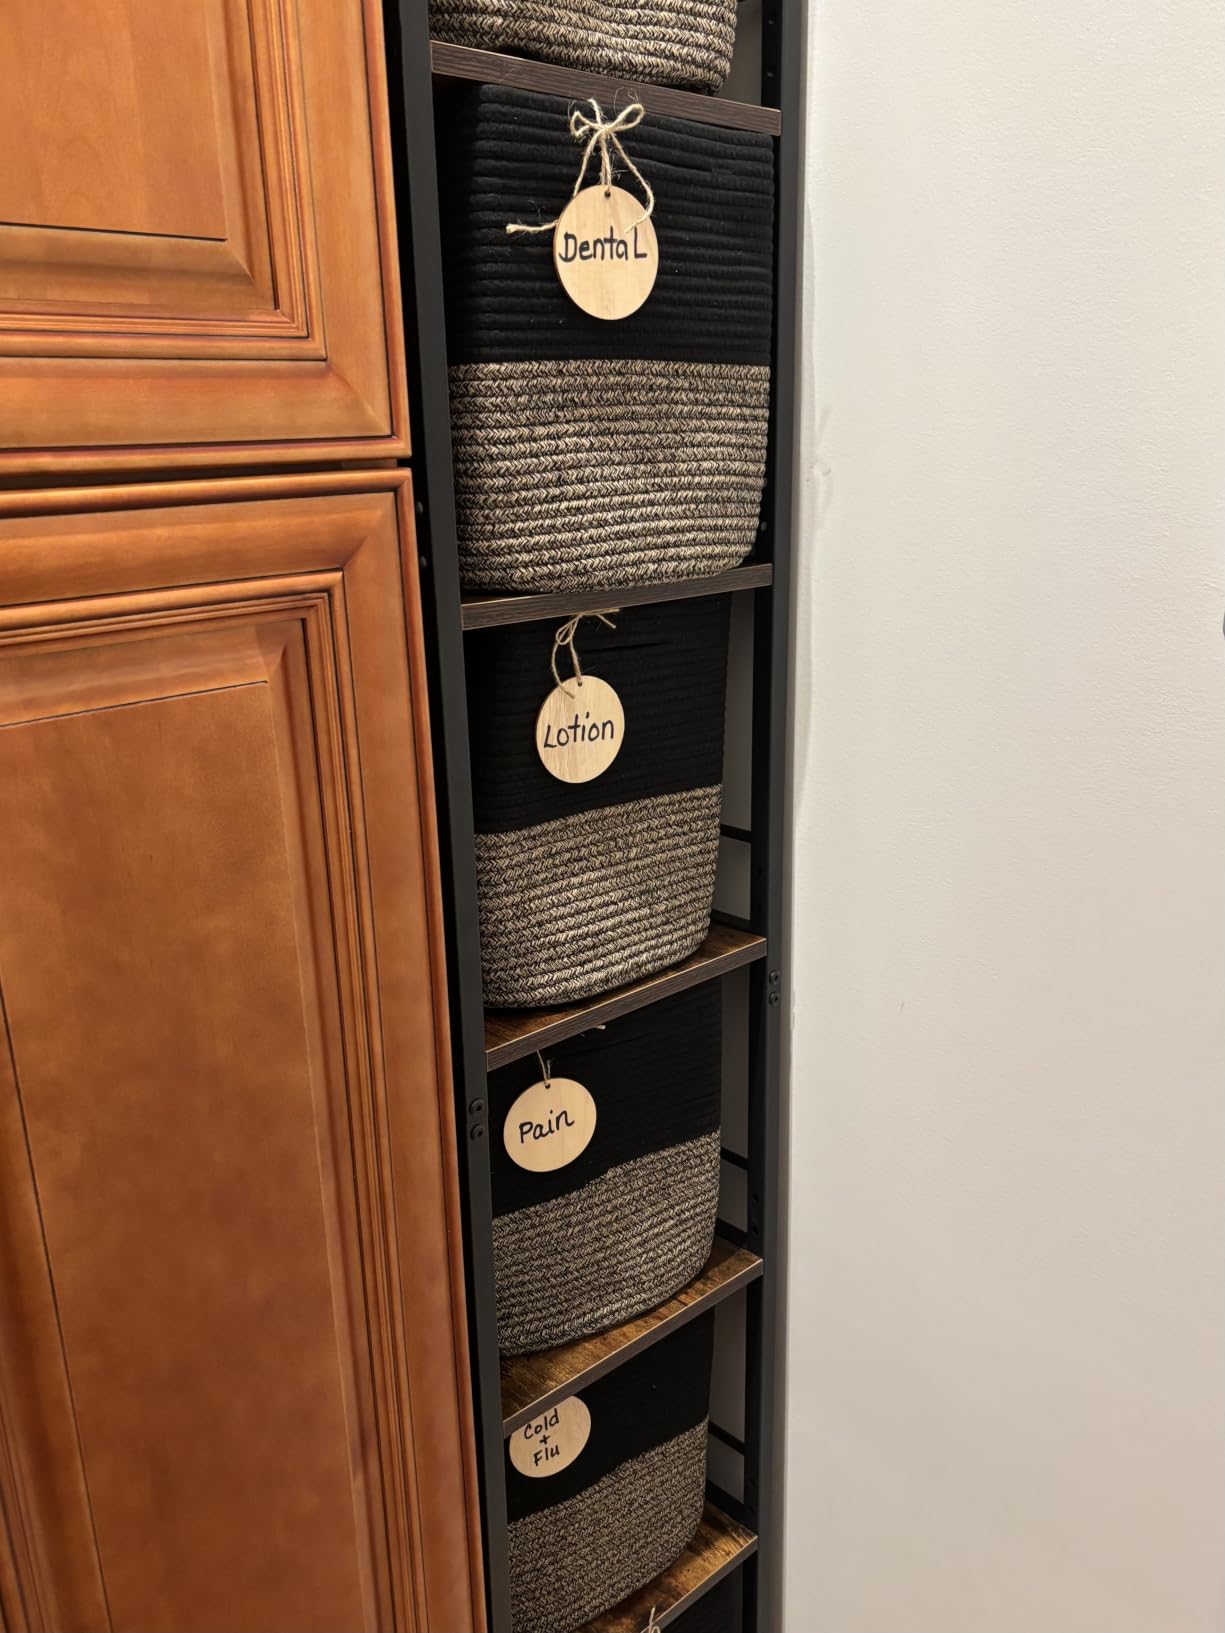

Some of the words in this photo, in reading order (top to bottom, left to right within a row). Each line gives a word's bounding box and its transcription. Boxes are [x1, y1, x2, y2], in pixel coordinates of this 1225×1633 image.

[543, 711, 615, 749] Lotion
[518, 1109, 576, 1144] Pain
[523, 1407, 560, 1440] Cold
[533, 1445, 560, 1467] Flu
